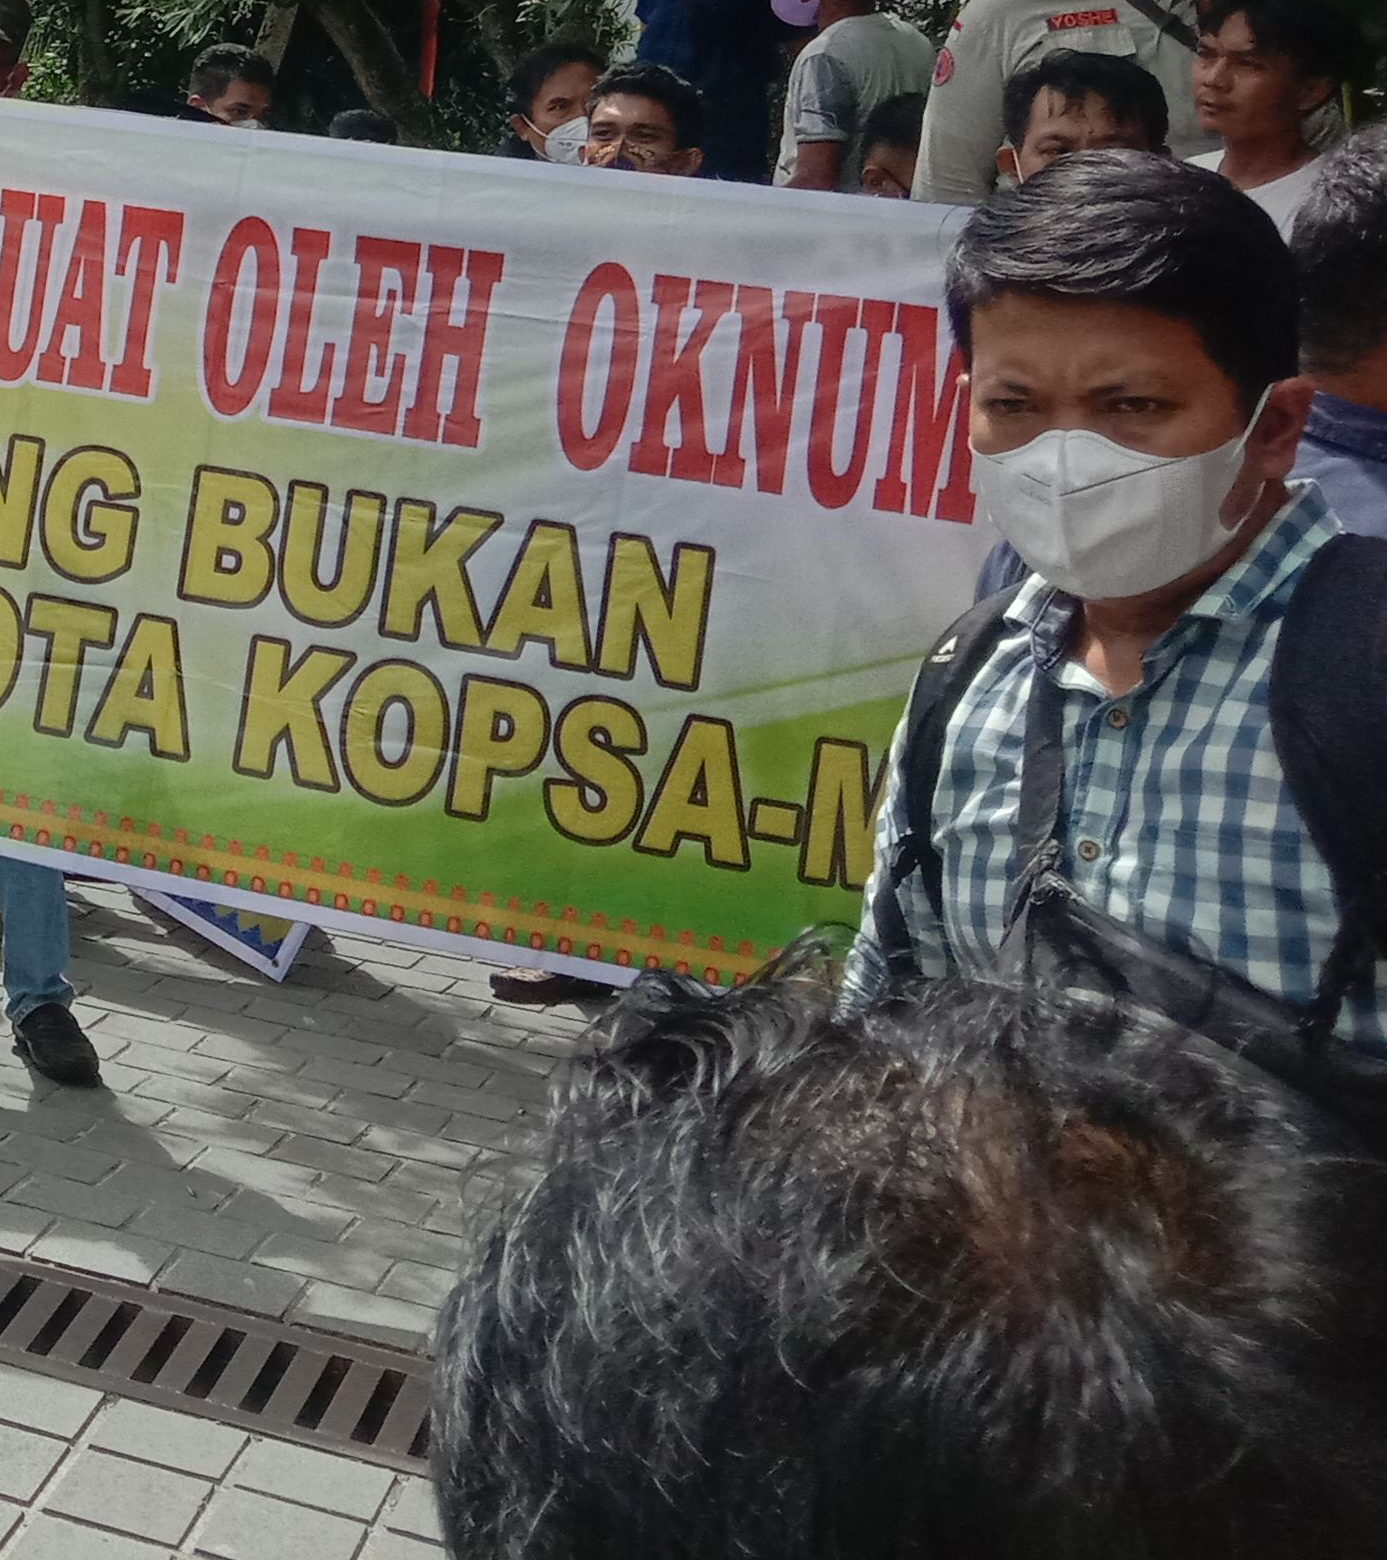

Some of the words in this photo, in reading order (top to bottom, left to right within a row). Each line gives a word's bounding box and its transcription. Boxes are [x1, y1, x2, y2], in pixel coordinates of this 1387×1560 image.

[203, 215, 505, 449] OLEH
[556, 261, 977, 525] OKNUM
[176, 464, 717, 692] BUKAN
[232, 634, 890, 892] KOPSA-M
